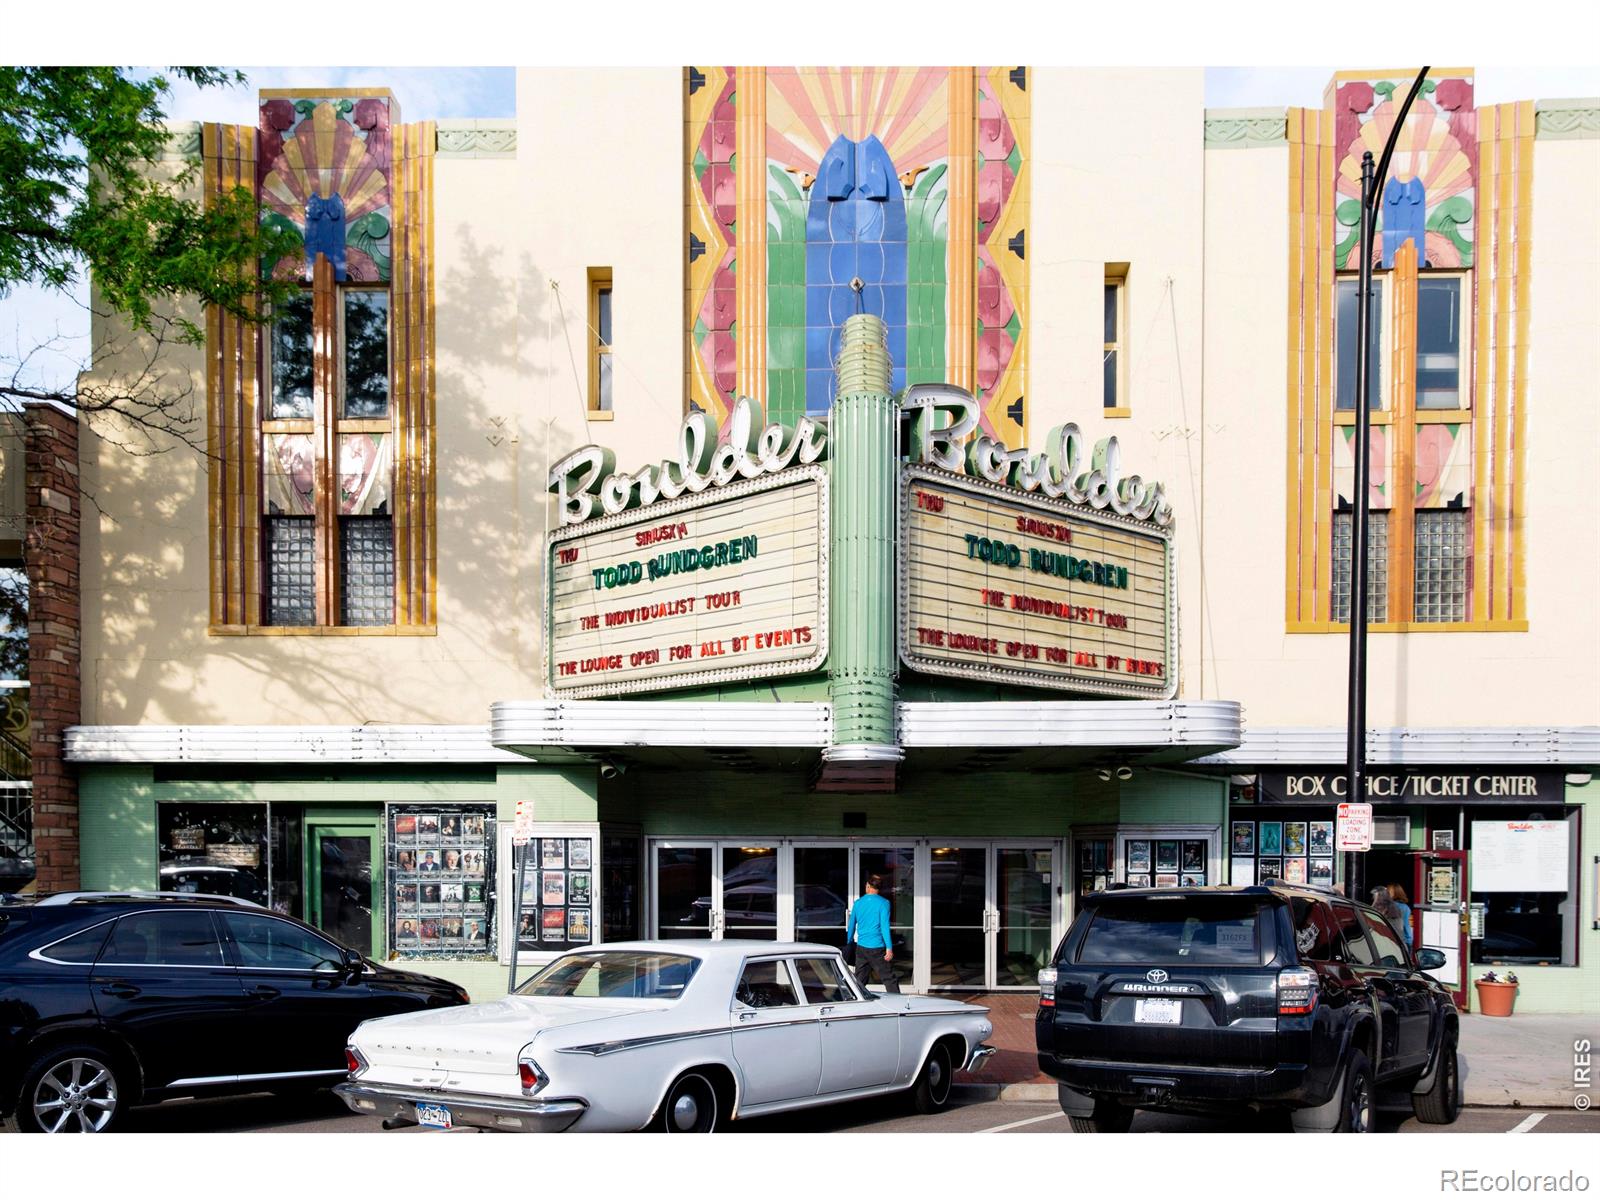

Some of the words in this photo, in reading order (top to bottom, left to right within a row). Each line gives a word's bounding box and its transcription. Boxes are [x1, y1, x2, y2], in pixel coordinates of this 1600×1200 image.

[549, 395, 829, 526] Boulder
[901, 383, 1174, 525] Boulder
[592, 561, 643, 590] TODD
[648, 535, 757, 581] RUNDGREN
[964, 533, 1020, 568] TODD
[1028, 547, 1128, 591] RUNDGREN
[580, 615, 599, 630] THE
[605, 597, 695, 628] INDIVIDUALIST
[704, 590, 740, 610] TOUR
[981, 588, 1005, 607] THE
[1010, 593, 1094, 624] INDIVIDUALIST
[1095, 609, 1128, 629] TOUR
[558, 661, 577, 676] THE
[580, 654, 623, 673] LOUNGE
[630, 649, 659, 667] OPEN
[669, 644, 692, 661] FOR
[700, 640, 725, 657] ALL
[732, 635, 749, 652] BT
[755, 626, 812, 649] EVENTS
[917, 627, 944, 647] THE
[948, 632, 998, 654] LOUNGE
[1006, 641, 1038, 659] OPEN
[1046, 646, 1067, 663] FOR
[1074, 651, 1097, 667] ALL
[1106, 655, 1120, 670] BT
[1126, 658, 1162, 676] EVENTS
[1286, 775, 1325, 796] BOX
[1330, 775, 1471, 797] OICE/TICKET
[1474, 775, 1538, 796] CENTER
[1123, 983, 1189, 993] 4RUNNER
